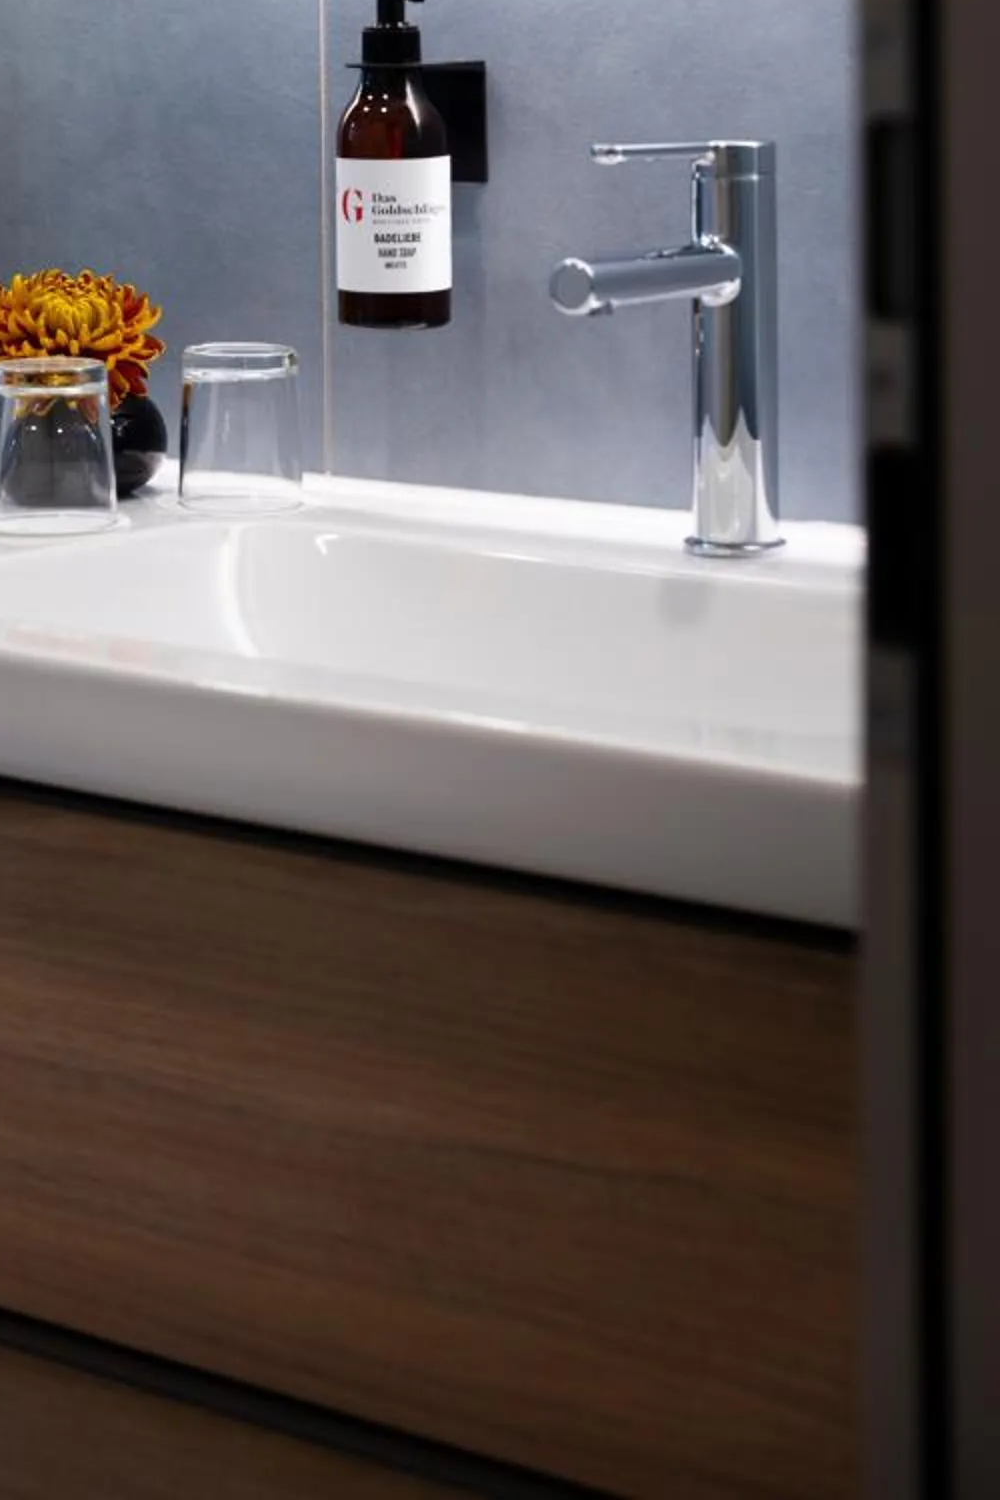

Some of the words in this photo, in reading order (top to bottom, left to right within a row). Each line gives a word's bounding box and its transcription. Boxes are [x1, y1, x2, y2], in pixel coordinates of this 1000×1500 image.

[342, 188, 363, 222] G
[372, 193, 397, 203] Das
[371, 204, 446, 218] Goldschl
